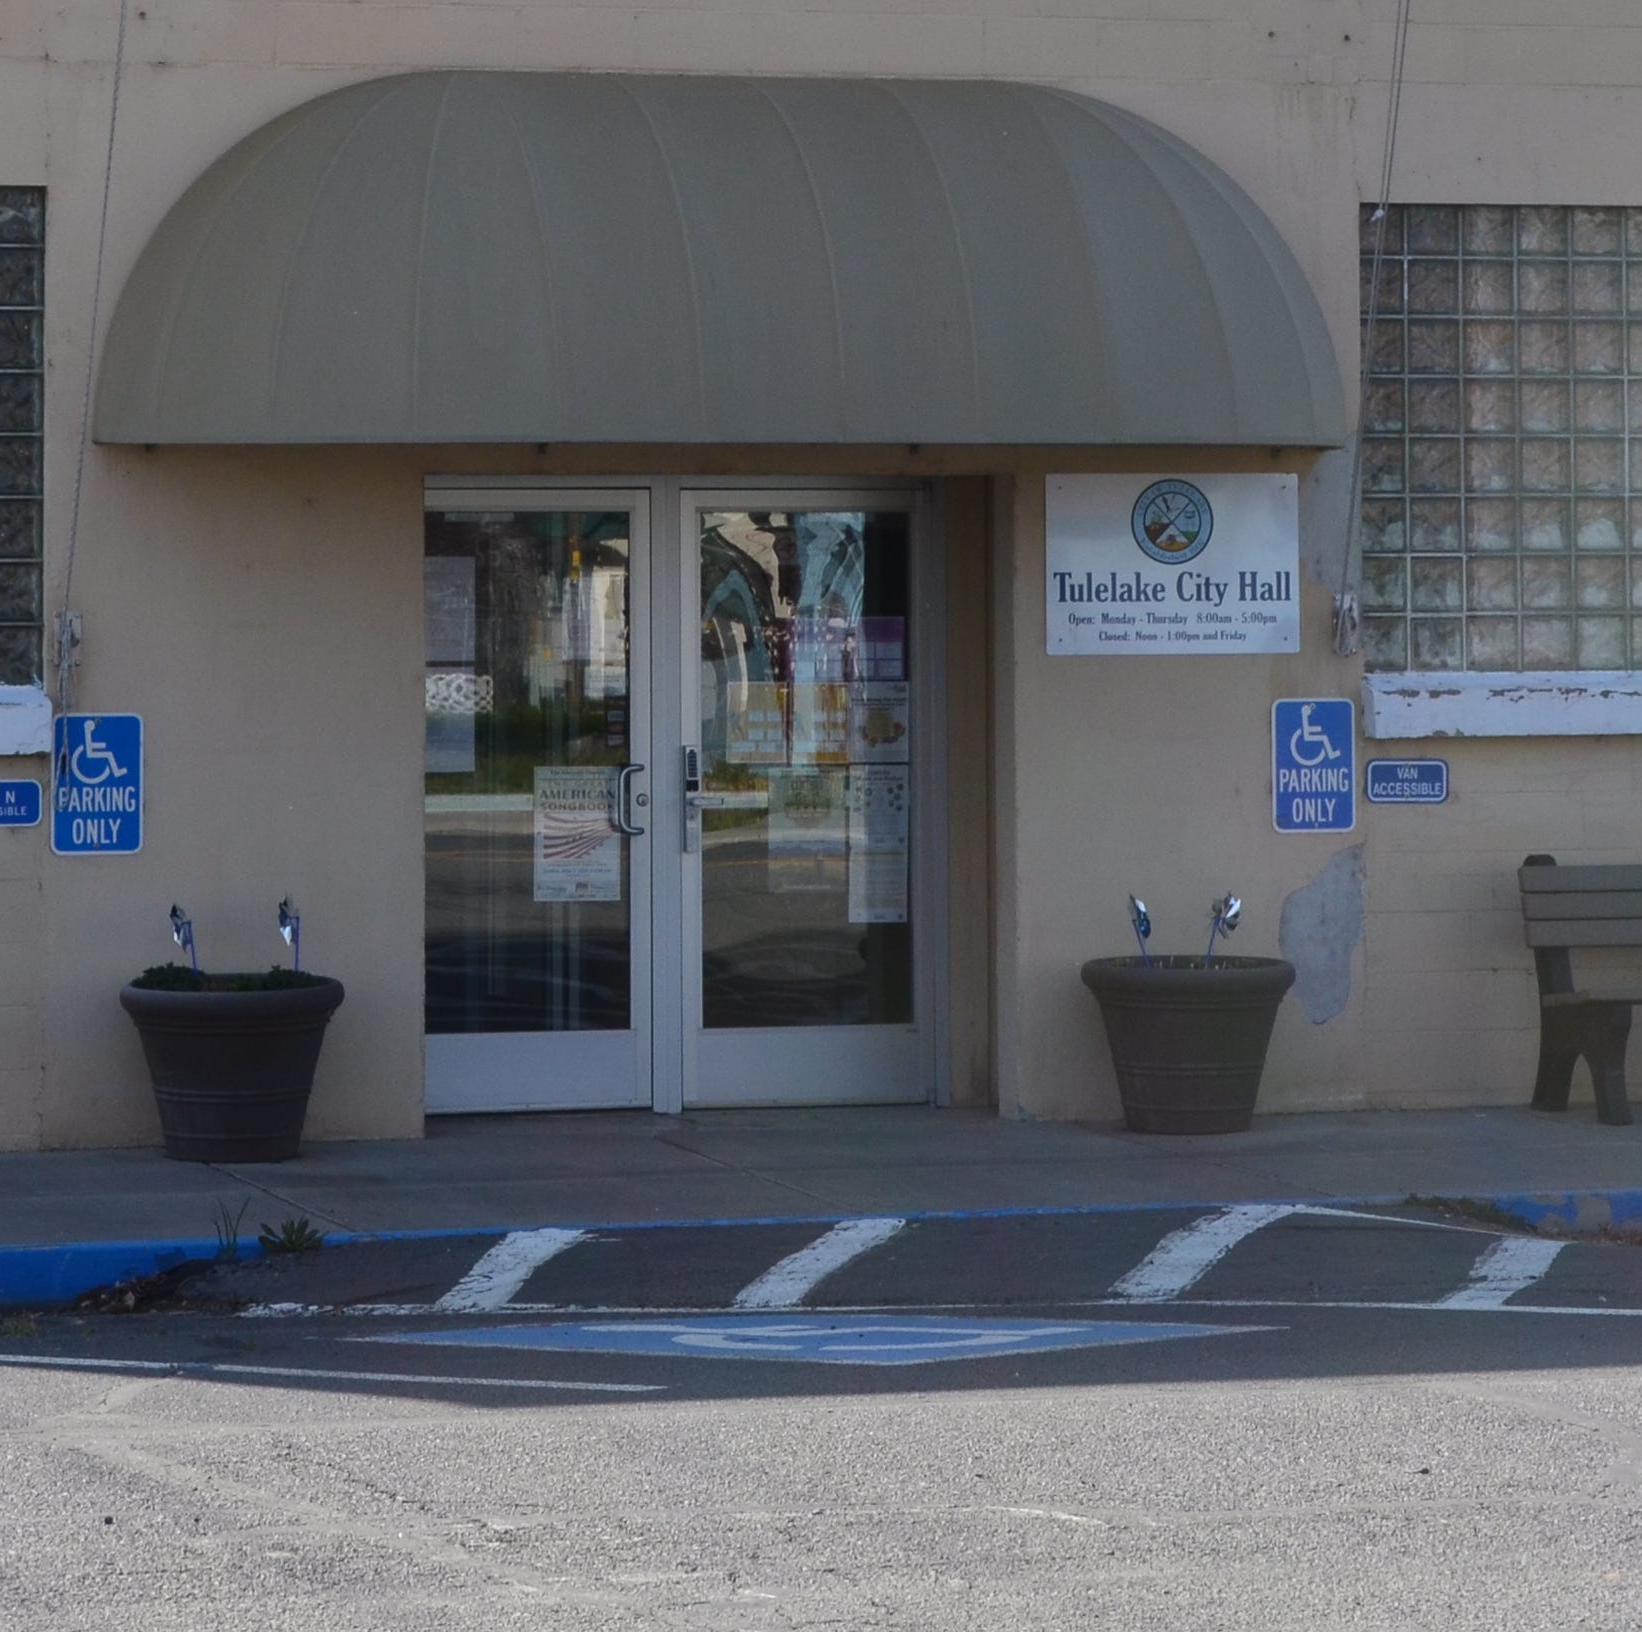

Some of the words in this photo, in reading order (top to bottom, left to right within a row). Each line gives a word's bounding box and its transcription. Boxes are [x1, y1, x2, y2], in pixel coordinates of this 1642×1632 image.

[1053, 571, 1166, 603] Tulelake
[1176, 571, 1229, 607] City
[1238, 571, 1291, 602] Hall
[1068, 613, 1095, 626] Open:
[1100, 613, 1137, 626] Monday
[1146, 612, 1188, 626] Thursday
[1196, 612, 1232, 624] 8:00am
[1241, 612, 1277, 625] 5:00pm
[1099, 630, 1131, 642] Closed:
[1135, 631, 1159, 641] Noon
[1167, 630, 1200, 643] 1:00pm
[1202, 630, 1218, 641] and
[1220, 630, 1247, 642] Friday
[1396, 767, 1418, 779] VAN
[1279, 768, 1349, 793] PARKING
[539, 789, 616, 801] AMERICAN
[1373, 782, 1442, 796] ACCESSIBLE
[58, 786, 136, 813] PARKING
[539, 802, 616, 812] SONGBOOK
[1292, 798, 1336, 823] ONLY
[71, 818, 121, 845] ONLY
